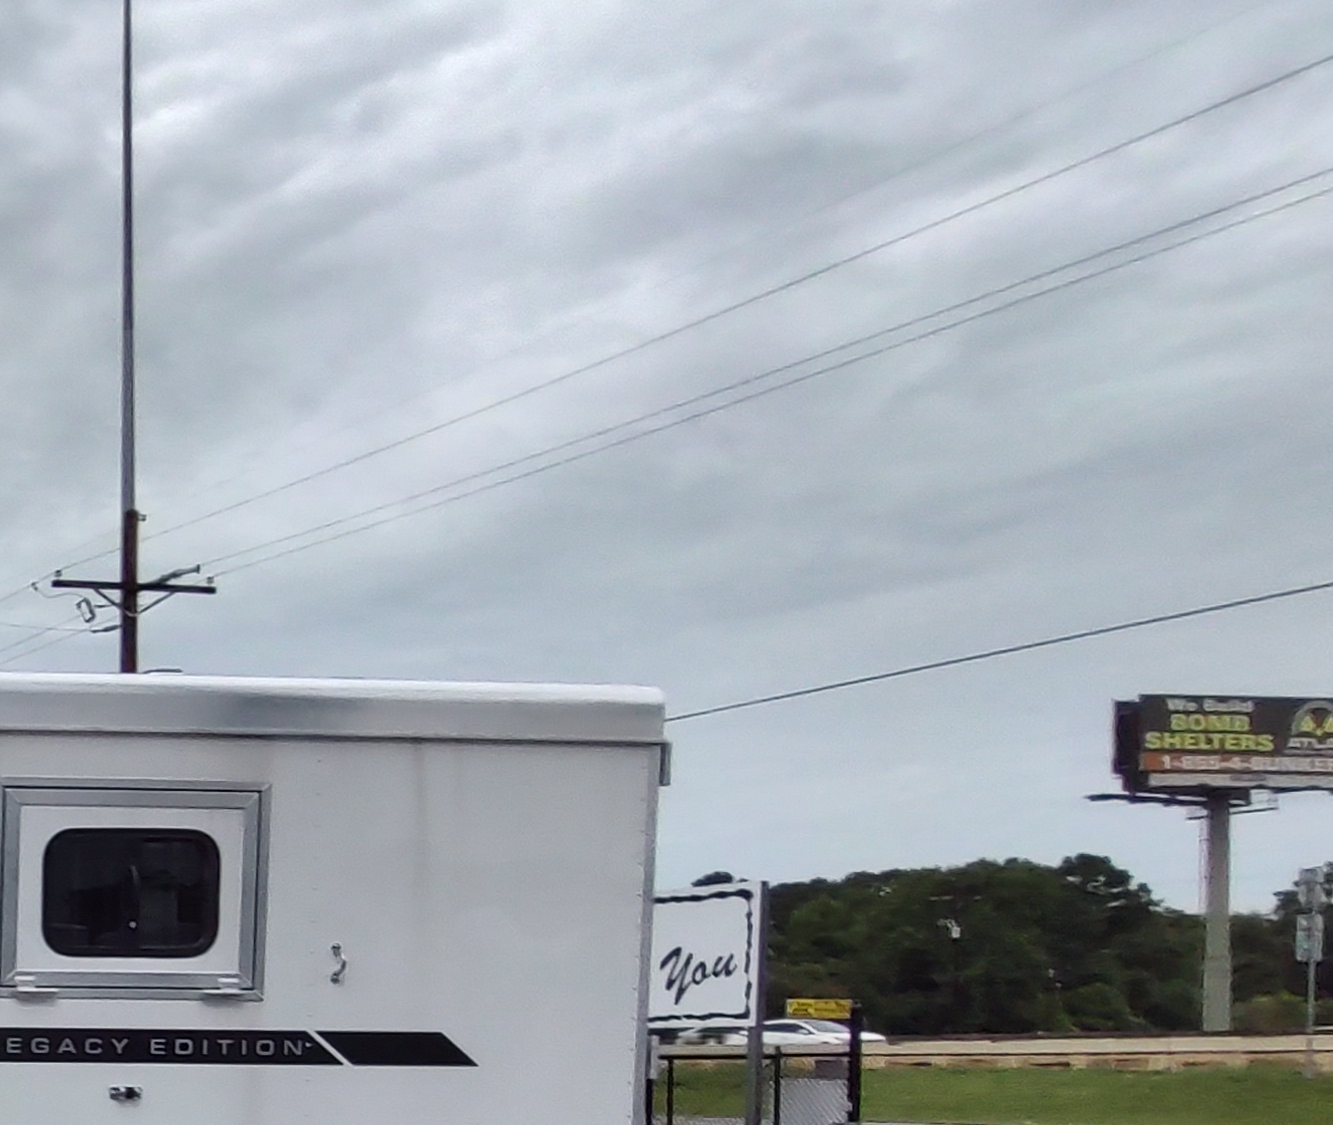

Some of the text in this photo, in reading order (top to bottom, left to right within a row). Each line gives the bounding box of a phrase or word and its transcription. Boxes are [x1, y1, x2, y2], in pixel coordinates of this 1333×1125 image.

[1170, 714, 1250, 730] BOMB
[1144, 731, 1274, 750] SHELTERS
[659, 946, 737, 1005] You
[149, 1039, 304, 1056] EDITION
